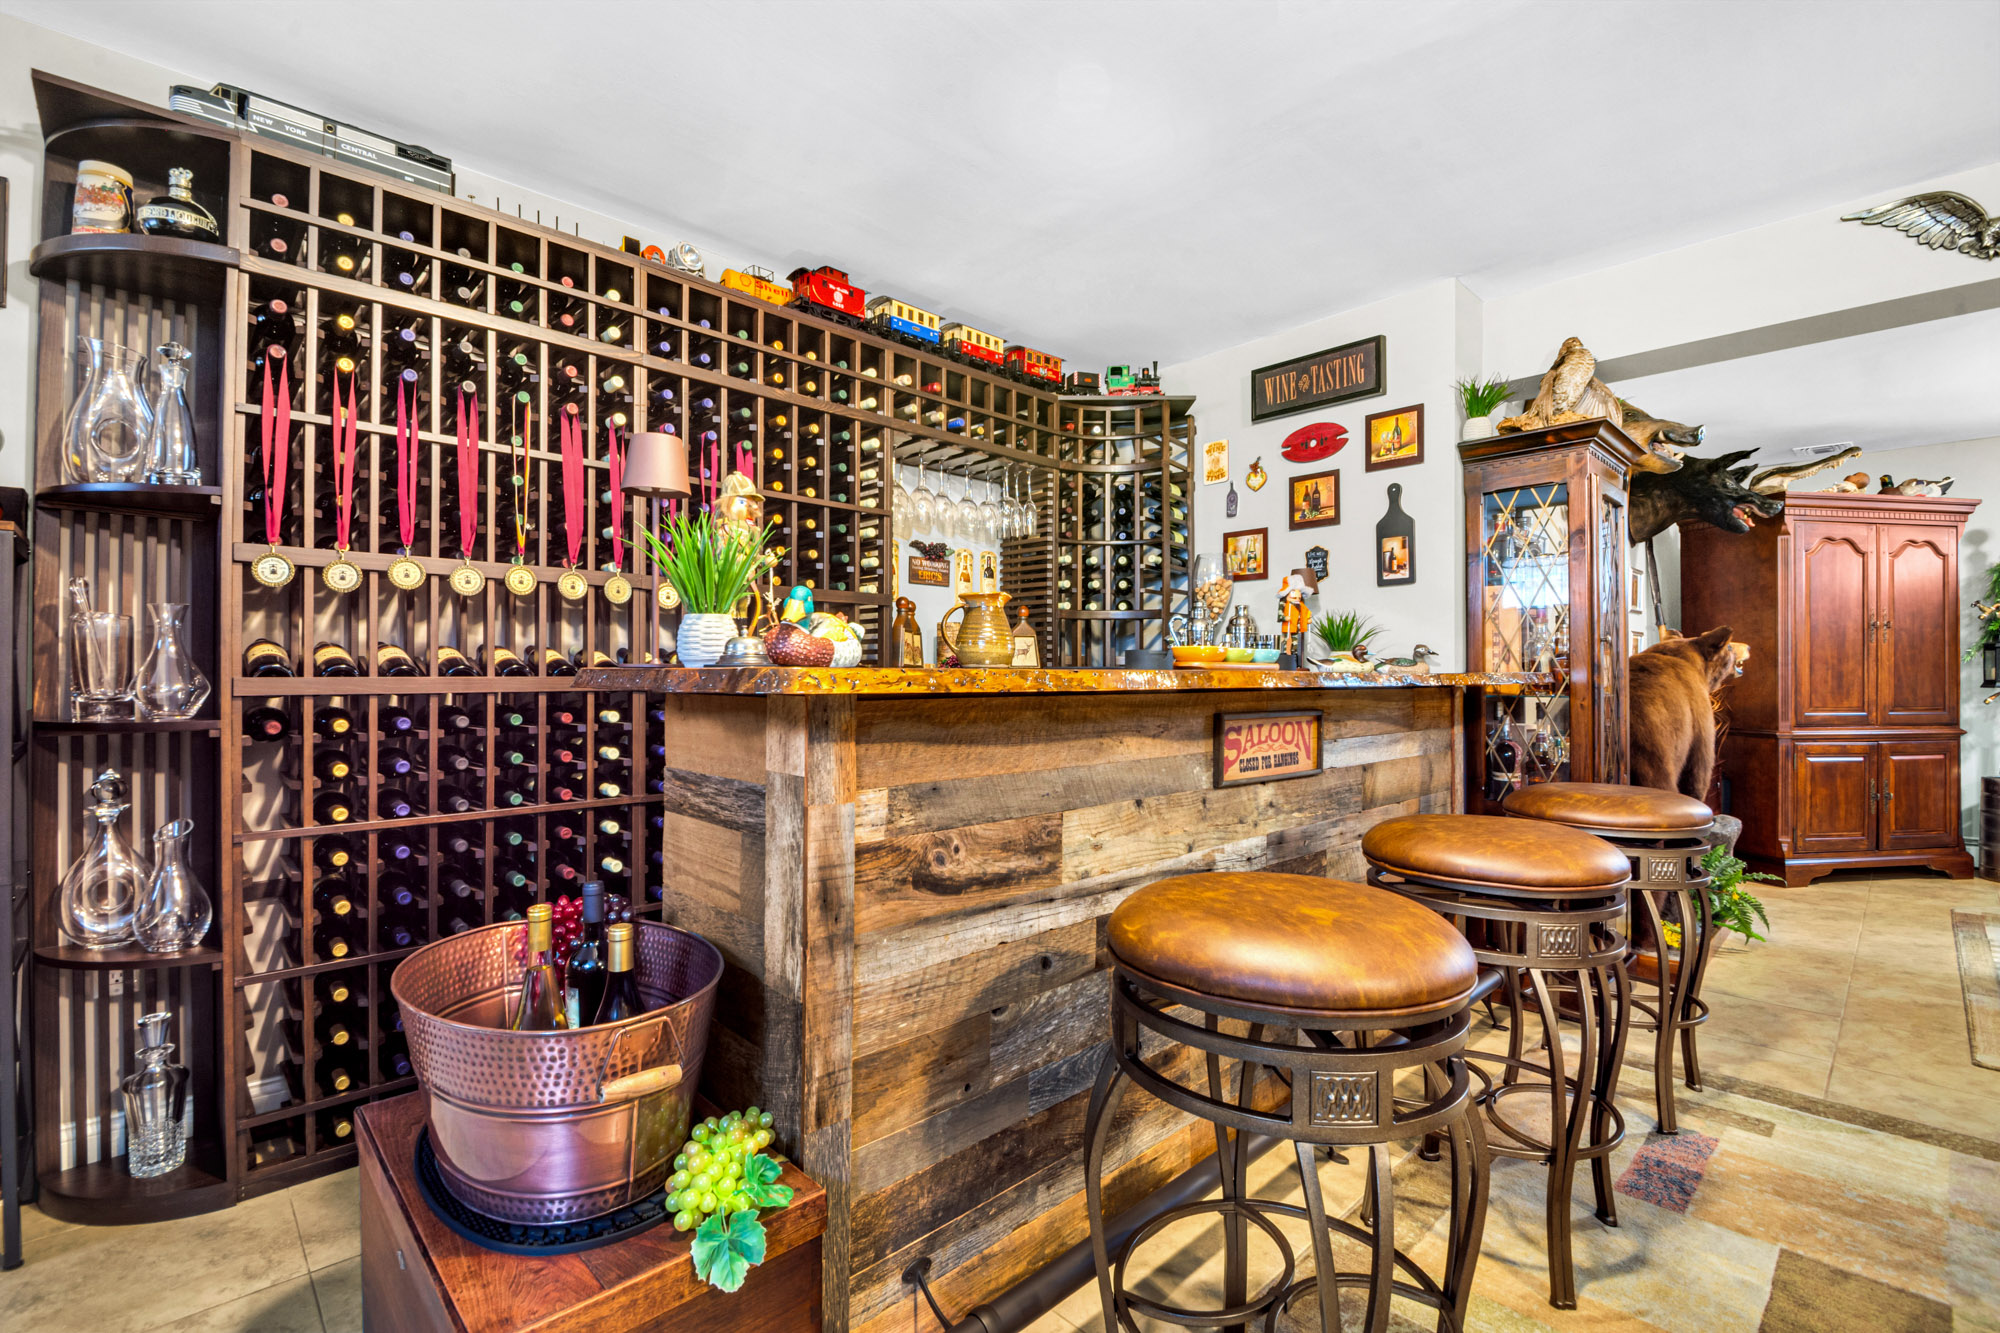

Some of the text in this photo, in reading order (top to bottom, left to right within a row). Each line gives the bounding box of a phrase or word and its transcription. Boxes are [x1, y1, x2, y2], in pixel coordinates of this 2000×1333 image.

[253, 114, 378, 160] NEW YORK CENTRAL
[755, 279, 789, 298] Shell
[1264, 352, 1365, 406] WINE TASTING
[918, 570, 942, 581] ERIC'S
[1224, 720, 1313, 775] SALOON
[1239, 756, 1260, 773] CLOSED
[1261, 755, 1272, 770] FOR
